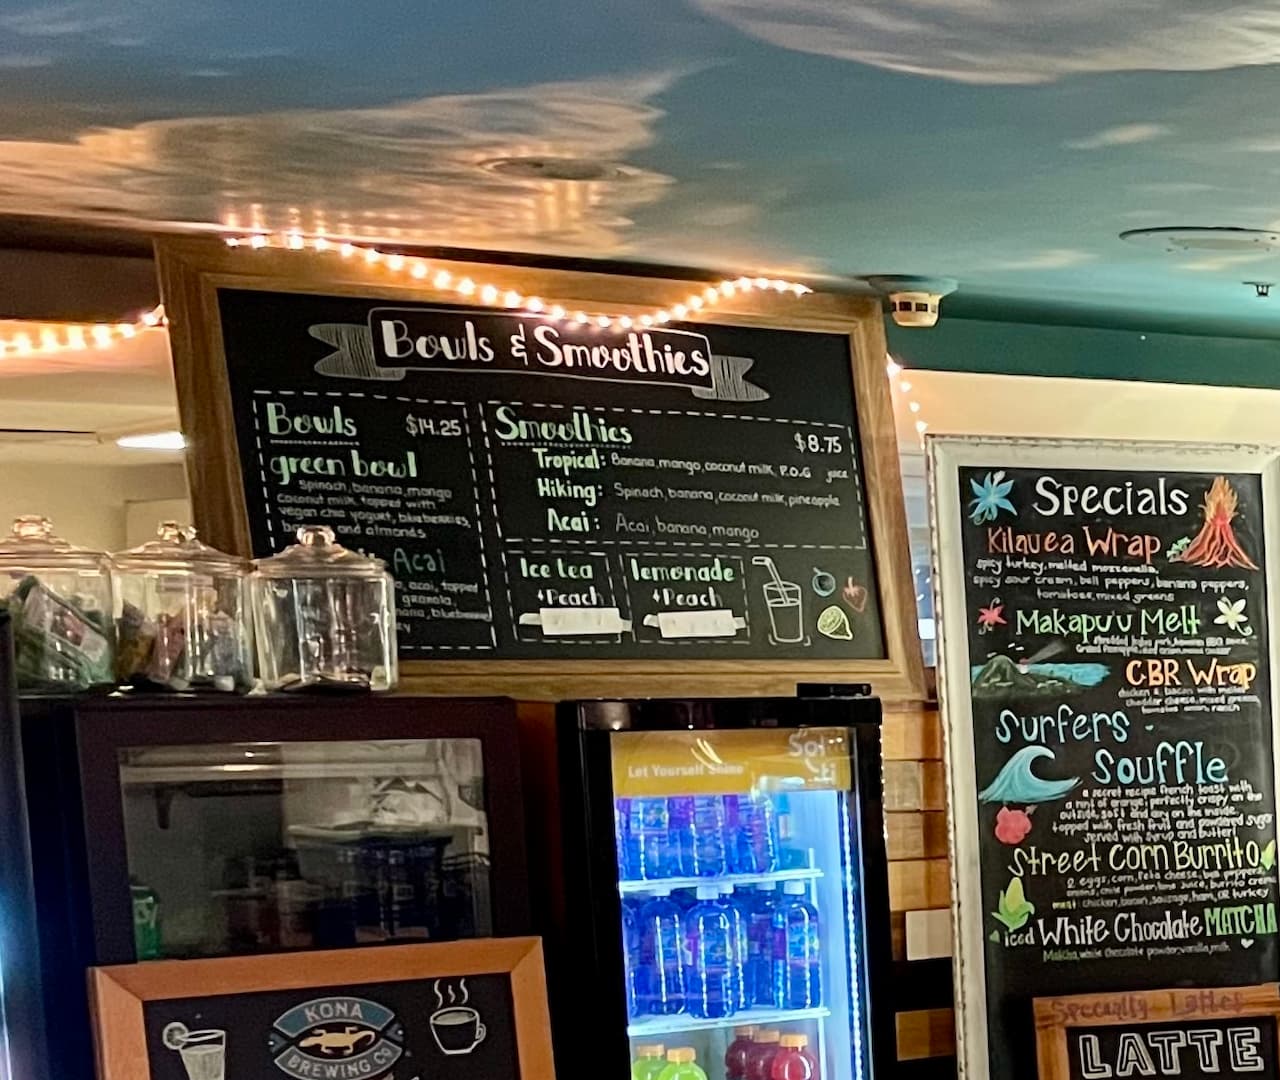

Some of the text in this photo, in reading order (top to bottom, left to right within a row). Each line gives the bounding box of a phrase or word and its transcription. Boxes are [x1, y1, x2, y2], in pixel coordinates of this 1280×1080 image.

[381, 319, 710, 376] Bowls & Smoothies
[266, 402, 462, 438] Bowls $14.25
[495, 406, 842, 454] Smoothies $8.75
[270, 450, 418, 485] green bowl
[1032, 475, 1190, 516] Specials
[393, 548, 446, 574] Acai
[987, 526, 1161, 565] Kilauea Wrap
[520, 557, 550, 579] Ice
[631, 558, 736, 582] lemonade
[1140, 605, 1200, 635] Melt
[1125, 659, 1257, 690] CBR Wrap
[995, 703, 1130, 744] Surfers
[1091, 741, 1228, 784] Souffle
[1007, 846, 1101, 877] Street
[1174, 837, 1260, 870] Burrito
[1004, 903, 1278, 947] iced White Chocolate MATCHA
[305, 1003, 363, 1022] KONA
[287, 1054, 371, 1078] BREWING
[1079, 1027, 1264, 1079] LATTE
